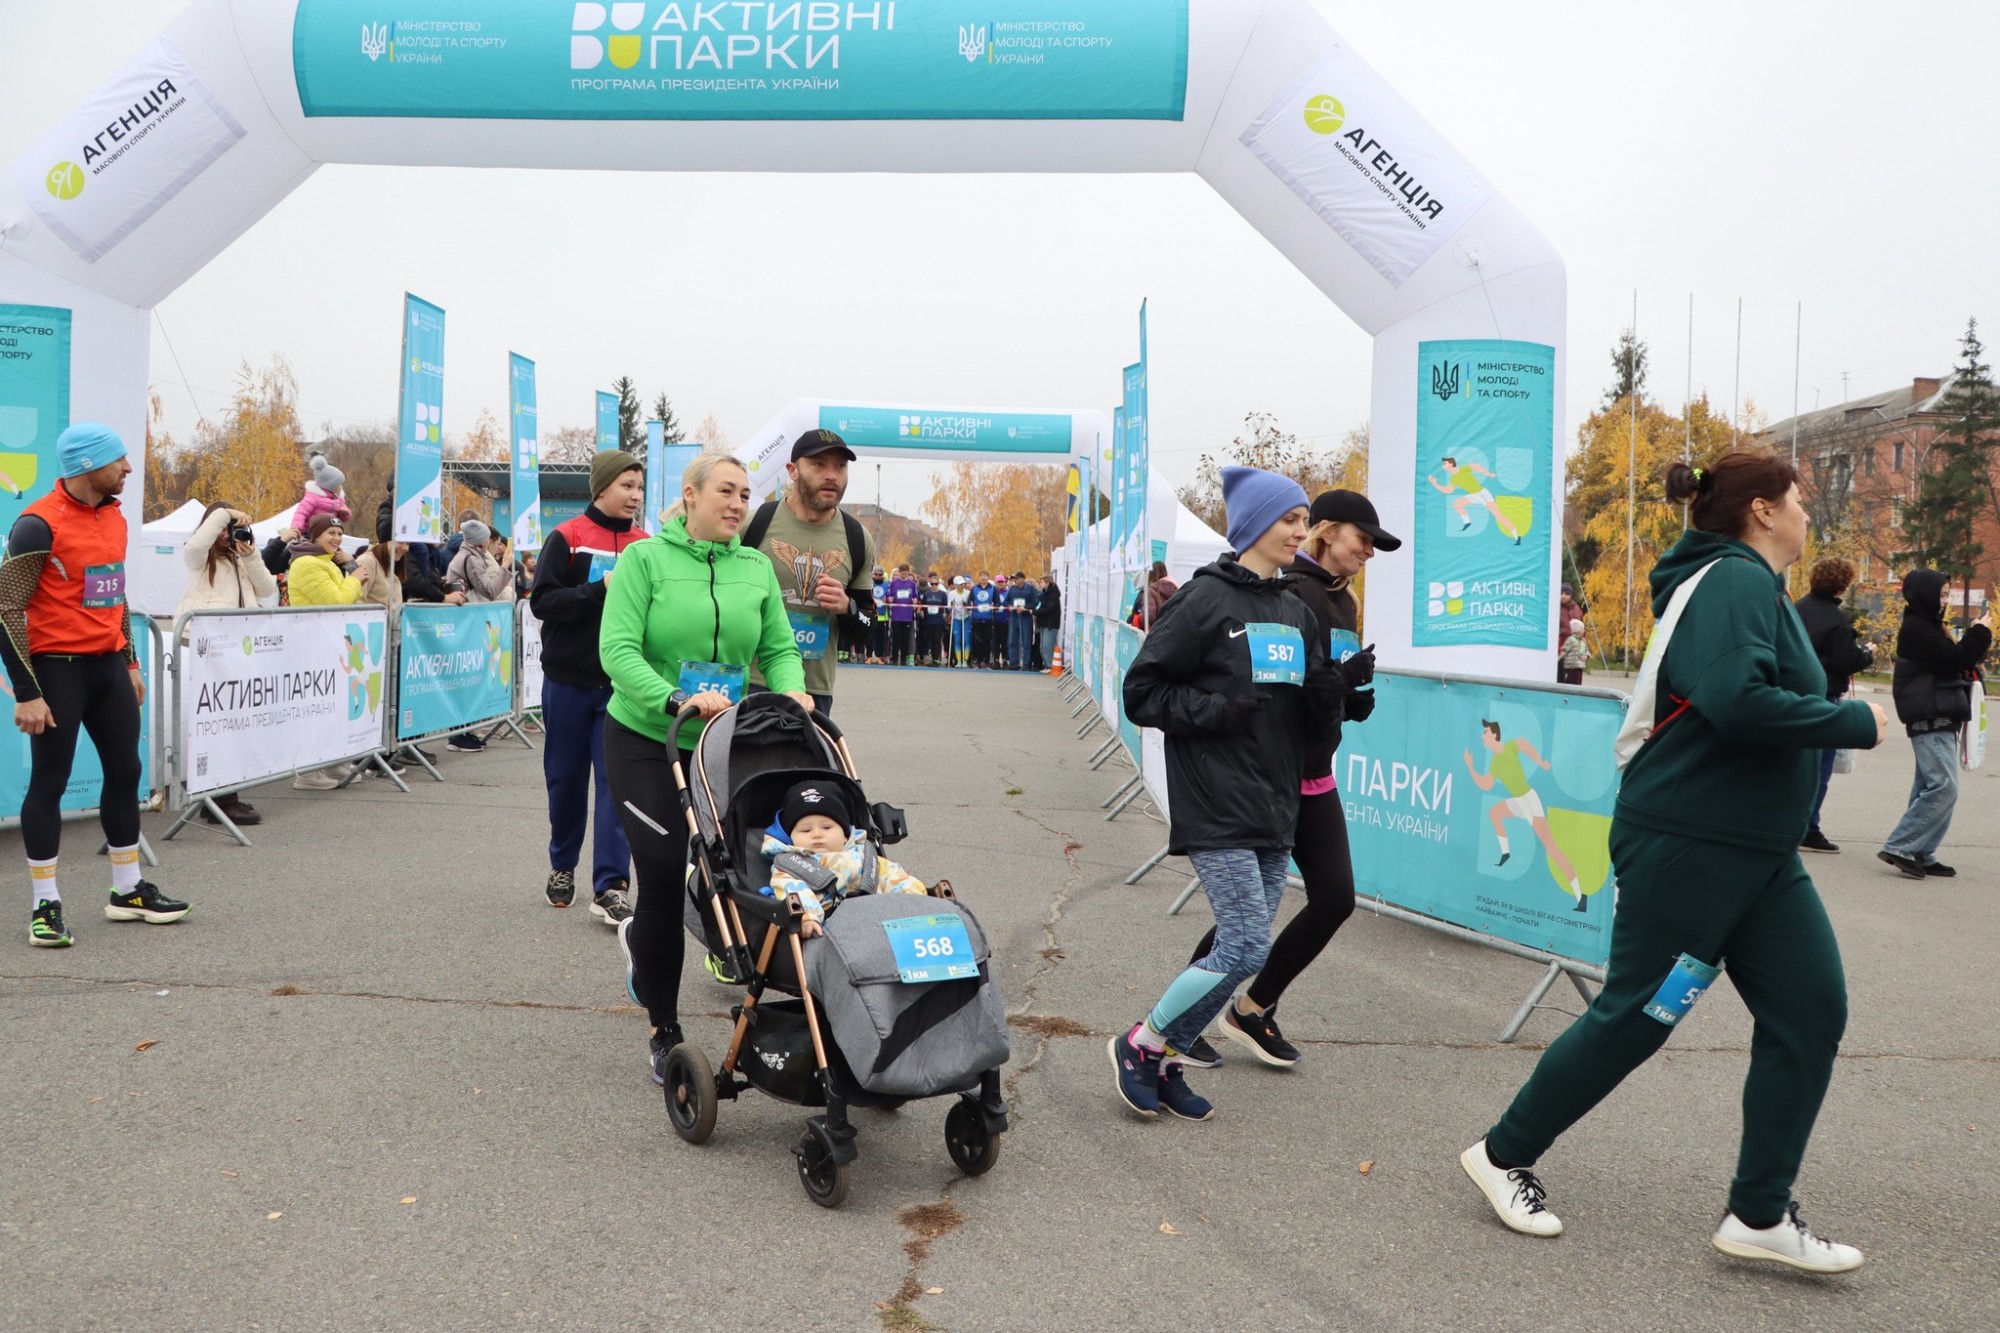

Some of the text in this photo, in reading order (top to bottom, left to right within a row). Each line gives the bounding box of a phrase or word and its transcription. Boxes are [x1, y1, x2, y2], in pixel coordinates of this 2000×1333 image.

[652, 1, 895, 31] АКТИВНІ
[397, 21, 481, 32] МІНІСТЕРСТВО
[995, 21, 1085, 32] МІНІСТЕРСТВО
[396, 37, 508, 48] МОЛОДІ ТА СПОРТУ
[995, 37, 1113, 48] МОЛОДІ ТА СПОРТУ
[395, 53, 442, 64] УКРАЇНИ
[650, 34, 840, 70] ПАРКИ
[995, 53, 1044, 65] УКРАЇНИ
[571, 76, 840, 92] ПРОГРАМА ПРЕЗИДЕНТА УКРАЇНИ
[82, 78, 178, 165] АГЕНЦІЯ
[92, 143, 131, 176] МАСОВОГО
[130, 121, 157, 146] СПОРТУ
[1333, 141, 1371, 178] МАСОВОГО
[1369, 175, 1398, 202] СПОРТУ
[1343, 127, 1444, 221] АГЕНЦІЯ
[1477, 362, 1545, 375] МІНІСТЕРСТВО
[1477, 375, 1519, 386] МОЛОДІ
[1477, 388, 1531, 400] ТА СПОРТУ
[922, 415, 991, 429] АКТИВНІ
[921, 426, 976, 439] ПАРКИ
[96, 578, 118, 593] 215
[1470, 581, 1536, 597] АКТИВНІ
[1470, 602, 1524, 617] ПАРКИ
[792, 629, 816, 644] 60
[1268, 644, 1295, 662] 587
[196, 668, 337, 715] АКТИВНІ ПАРКИ
[196, 713, 251, 738] ПРОГРАМА
[1347, 753, 1453, 815] ПАРКИ
[1386, 810, 1449, 845] УКРАЇНИ
[913, 936, 954, 958] 568
